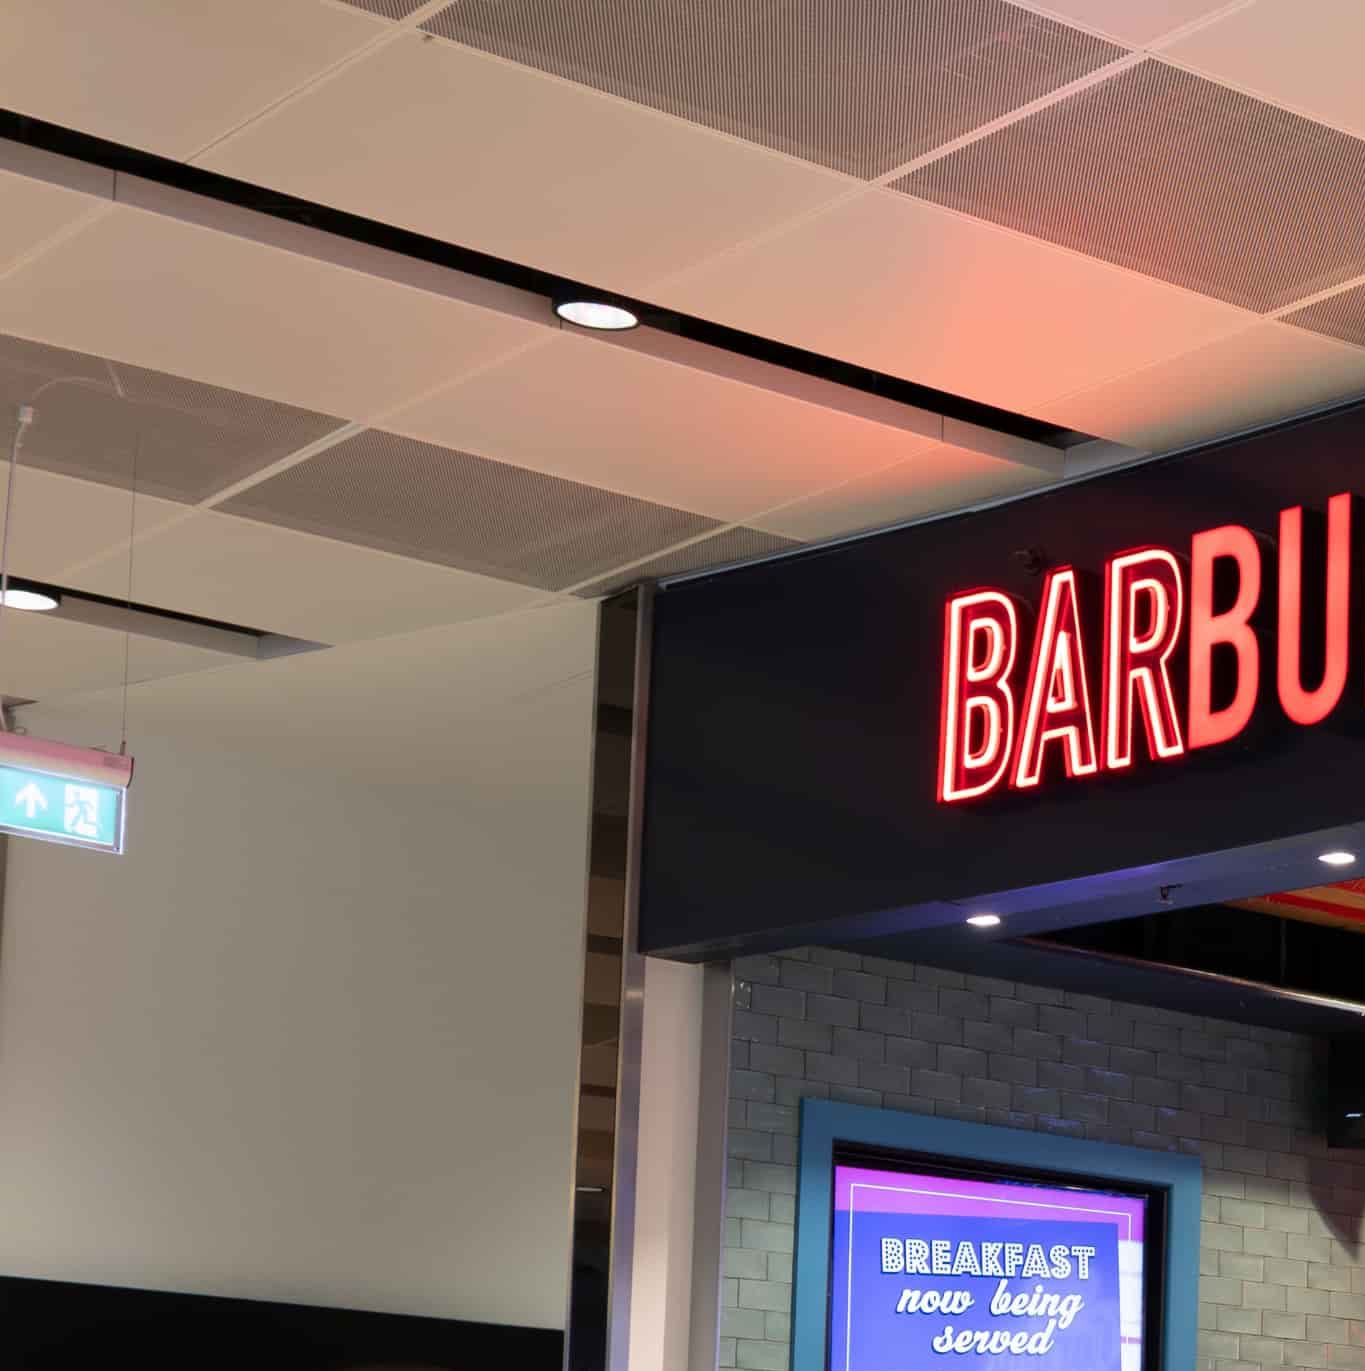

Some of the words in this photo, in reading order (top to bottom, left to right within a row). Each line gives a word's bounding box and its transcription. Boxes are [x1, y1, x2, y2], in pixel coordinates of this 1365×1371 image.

[881, 1237, 1095, 1281] BREAKFAST
[897, 1287, 974, 1316] now
[989, 1282, 1085, 1329] being
[933, 1321, 1054, 1357] served
